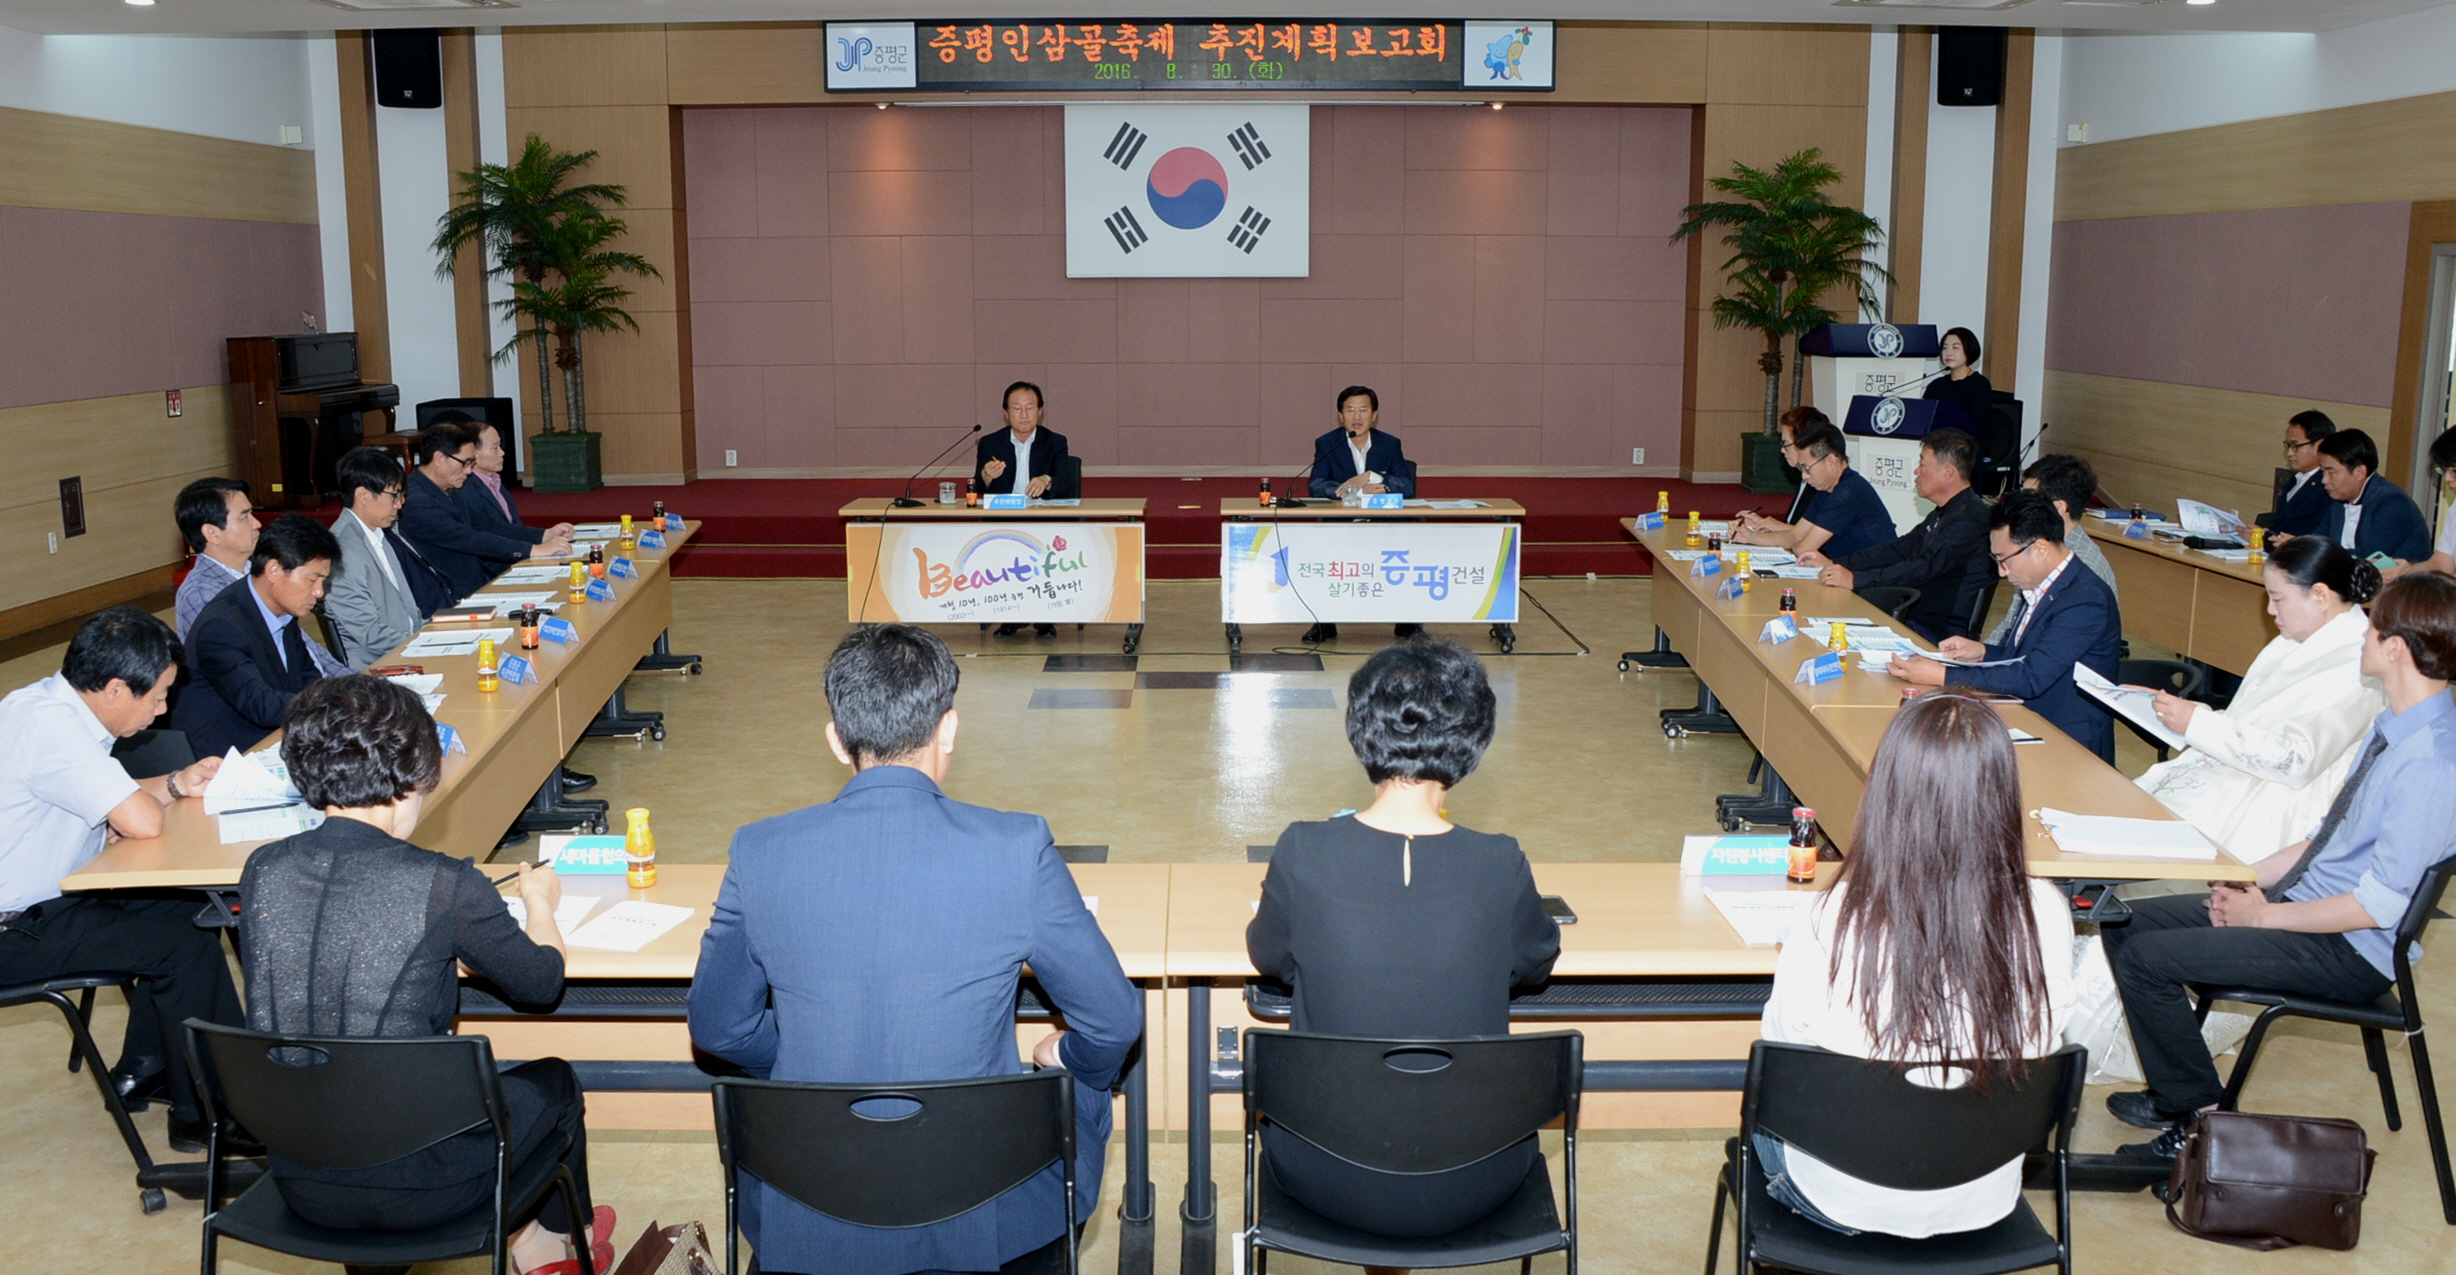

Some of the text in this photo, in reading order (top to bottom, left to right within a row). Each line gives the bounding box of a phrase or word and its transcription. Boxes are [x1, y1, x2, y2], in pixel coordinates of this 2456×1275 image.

[929, 23, 1446, 63] 증평인삼골축제 추진계획보고회
[874, 45, 908, 64] 증평군
[862, 65, 908, 74] Jeung Pyeong
[1094, 61, 1285, 80] 2016. 8. 30. (화)
[1864, 374, 1896, 393] 증평군
[1875, 457, 1904, 478] 증평군
[1886, 478, 1908, 489] Pyeong
[912, 547, 1088, 600] Beautiful
[1298, 549, 1485, 601] 전국 최고의 증평 건설
[958, 597, 981, 608] 10년,
[983, 593, 1009, 604] 100년
[1026, 580, 1084, 600] 거듭나다!
